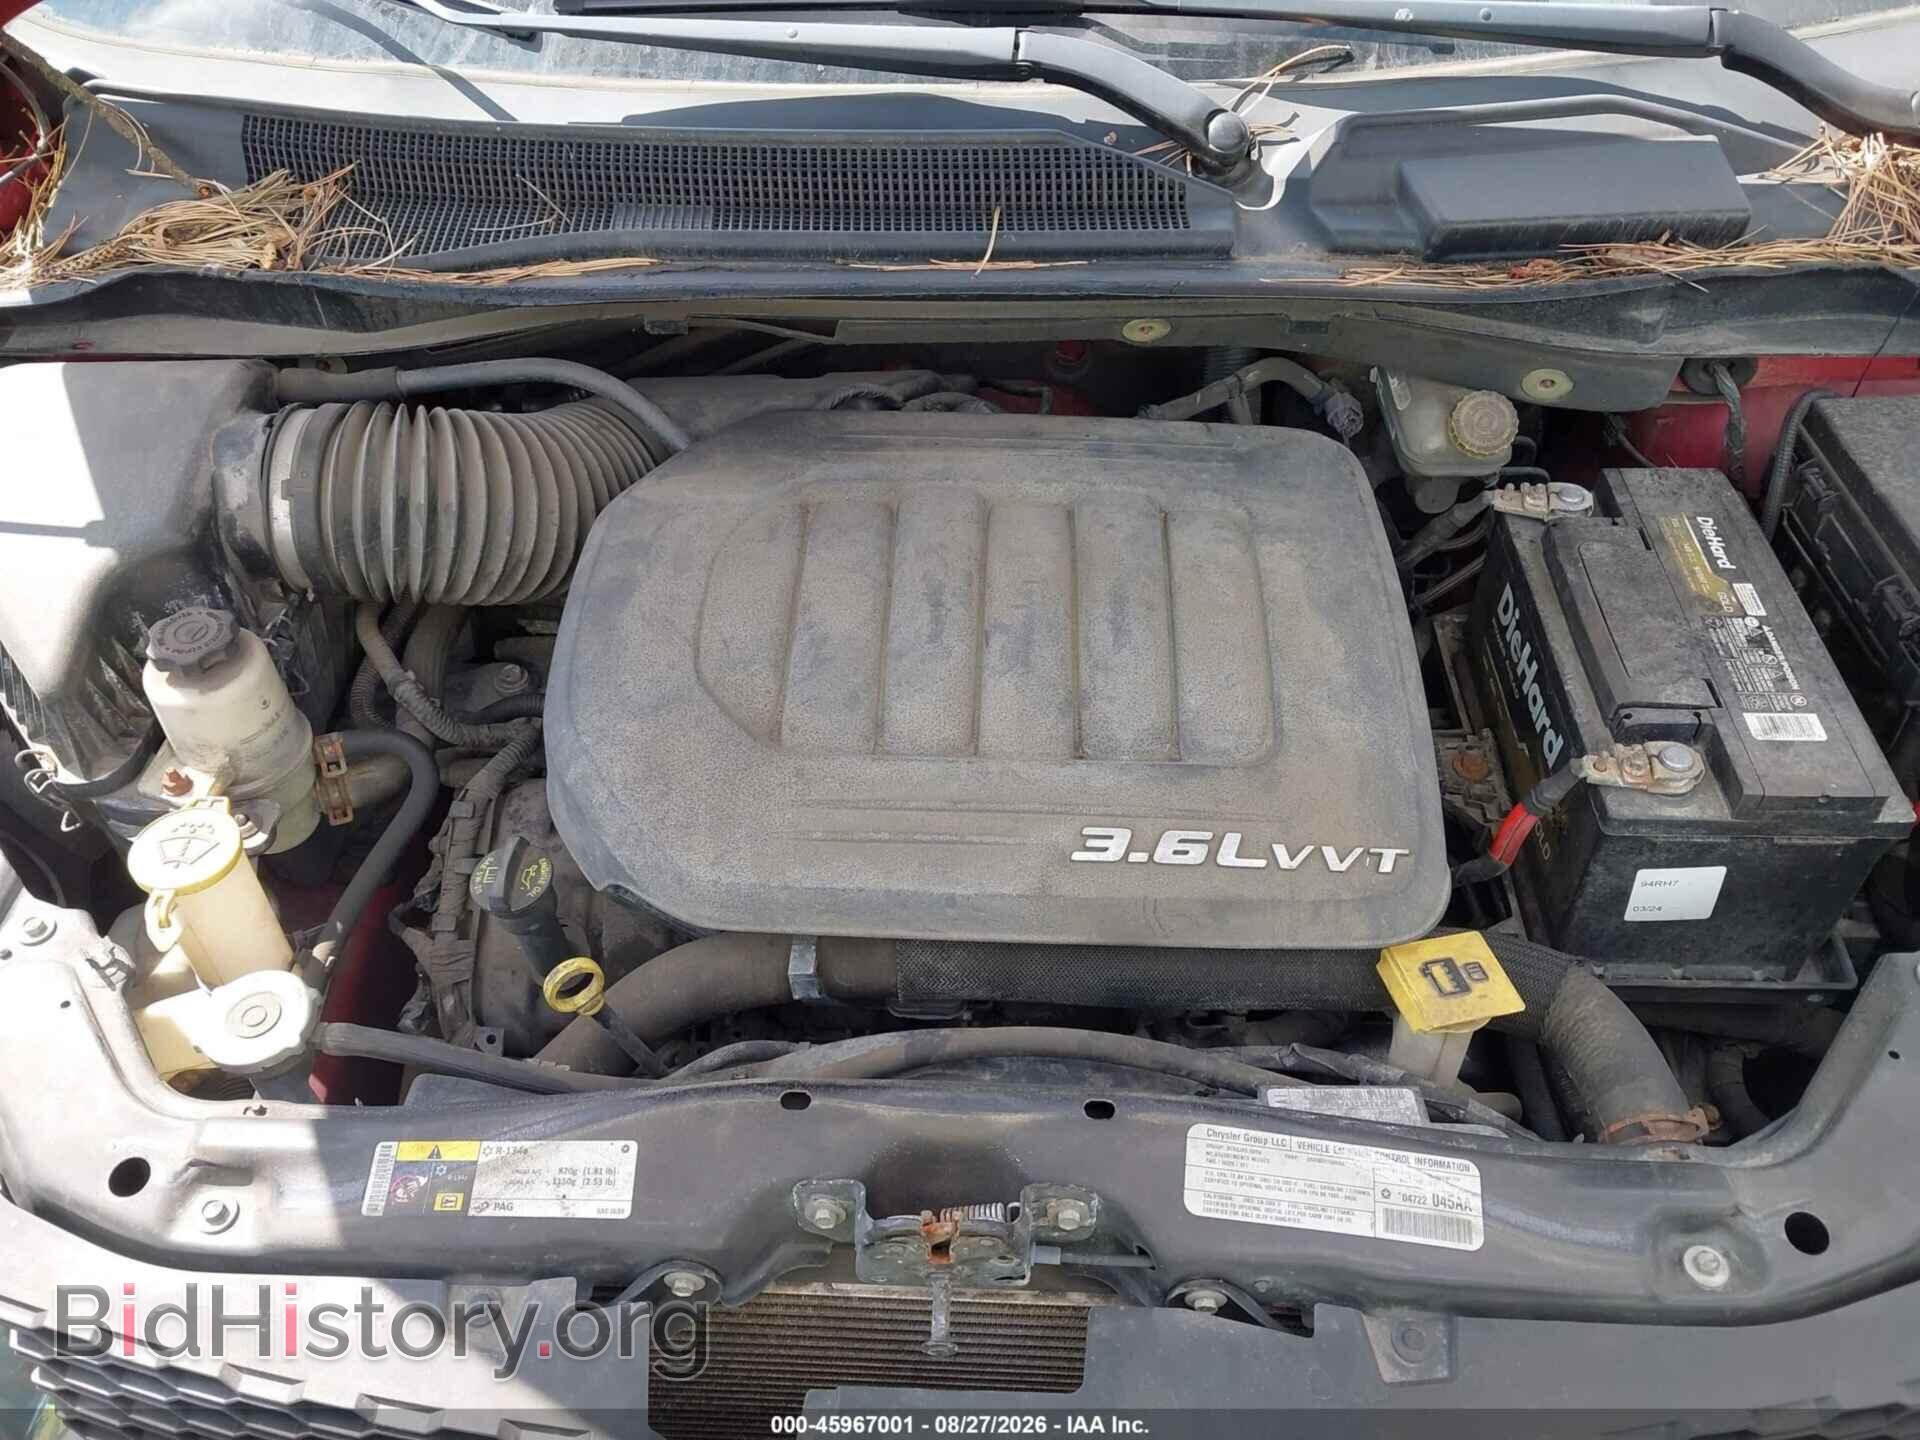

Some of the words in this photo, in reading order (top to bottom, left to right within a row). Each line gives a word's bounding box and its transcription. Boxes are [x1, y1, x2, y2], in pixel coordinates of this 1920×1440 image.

[1696, 516, 1736, 569] DieHard
[1497, 582, 1565, 769] DieHard
[1206, 1127, 1241, 1141] Chrysler
[1243, 1133, 1269, 1147] Group
[1271, 1138, 1288, 1147] LLC
[1296, 1140, 1330, 1154] VEHICLE
[1414, 1156, 1470, 1173] INFORMATION
[493, 1202, 514, 1212] PAG
